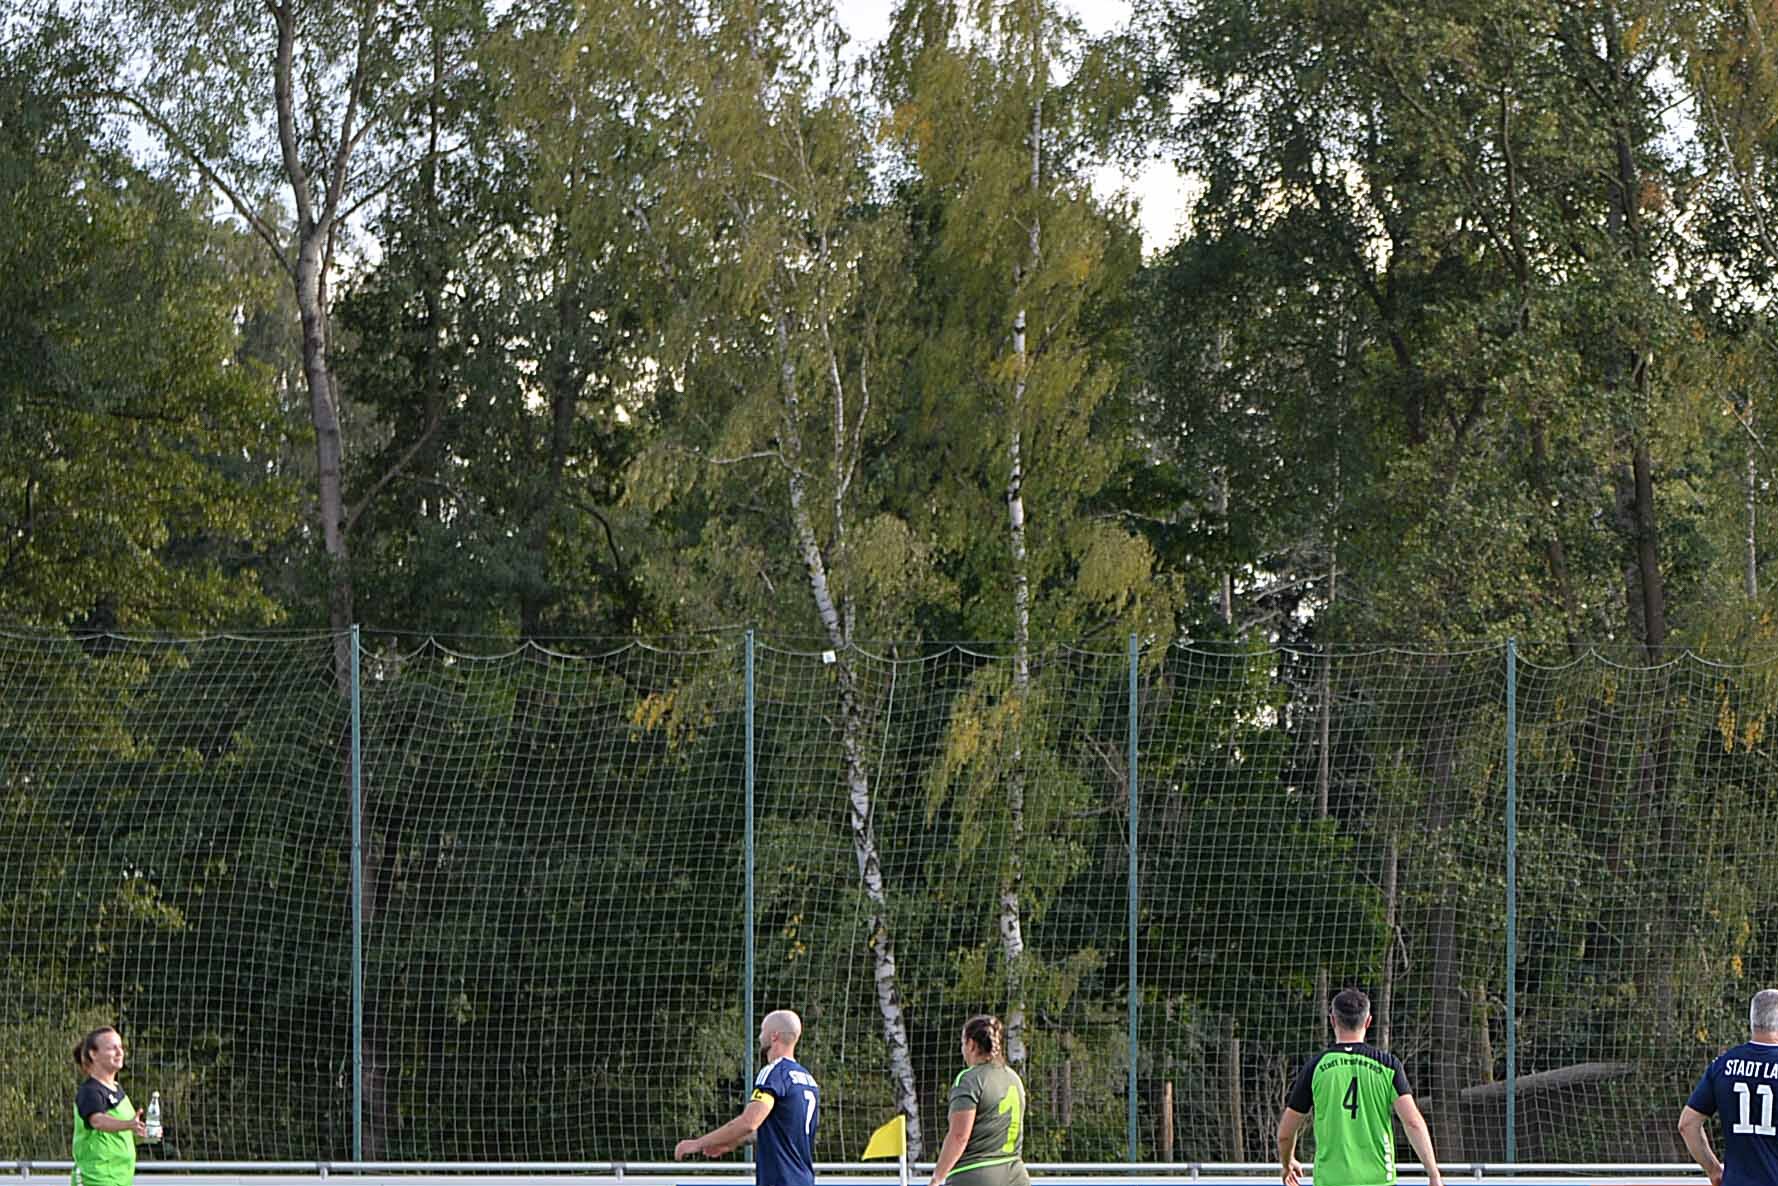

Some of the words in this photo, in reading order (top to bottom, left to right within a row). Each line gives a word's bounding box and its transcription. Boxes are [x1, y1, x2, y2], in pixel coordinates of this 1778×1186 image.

[1724, 1059, 1762, 1078] STADT
[802, 1089, 816, 1135] 7
[998, 1085, 1020, 1153] 1
[1342, 1076, 1359, 1120] 4
[1732, 1082, 1777, 1136] 11
